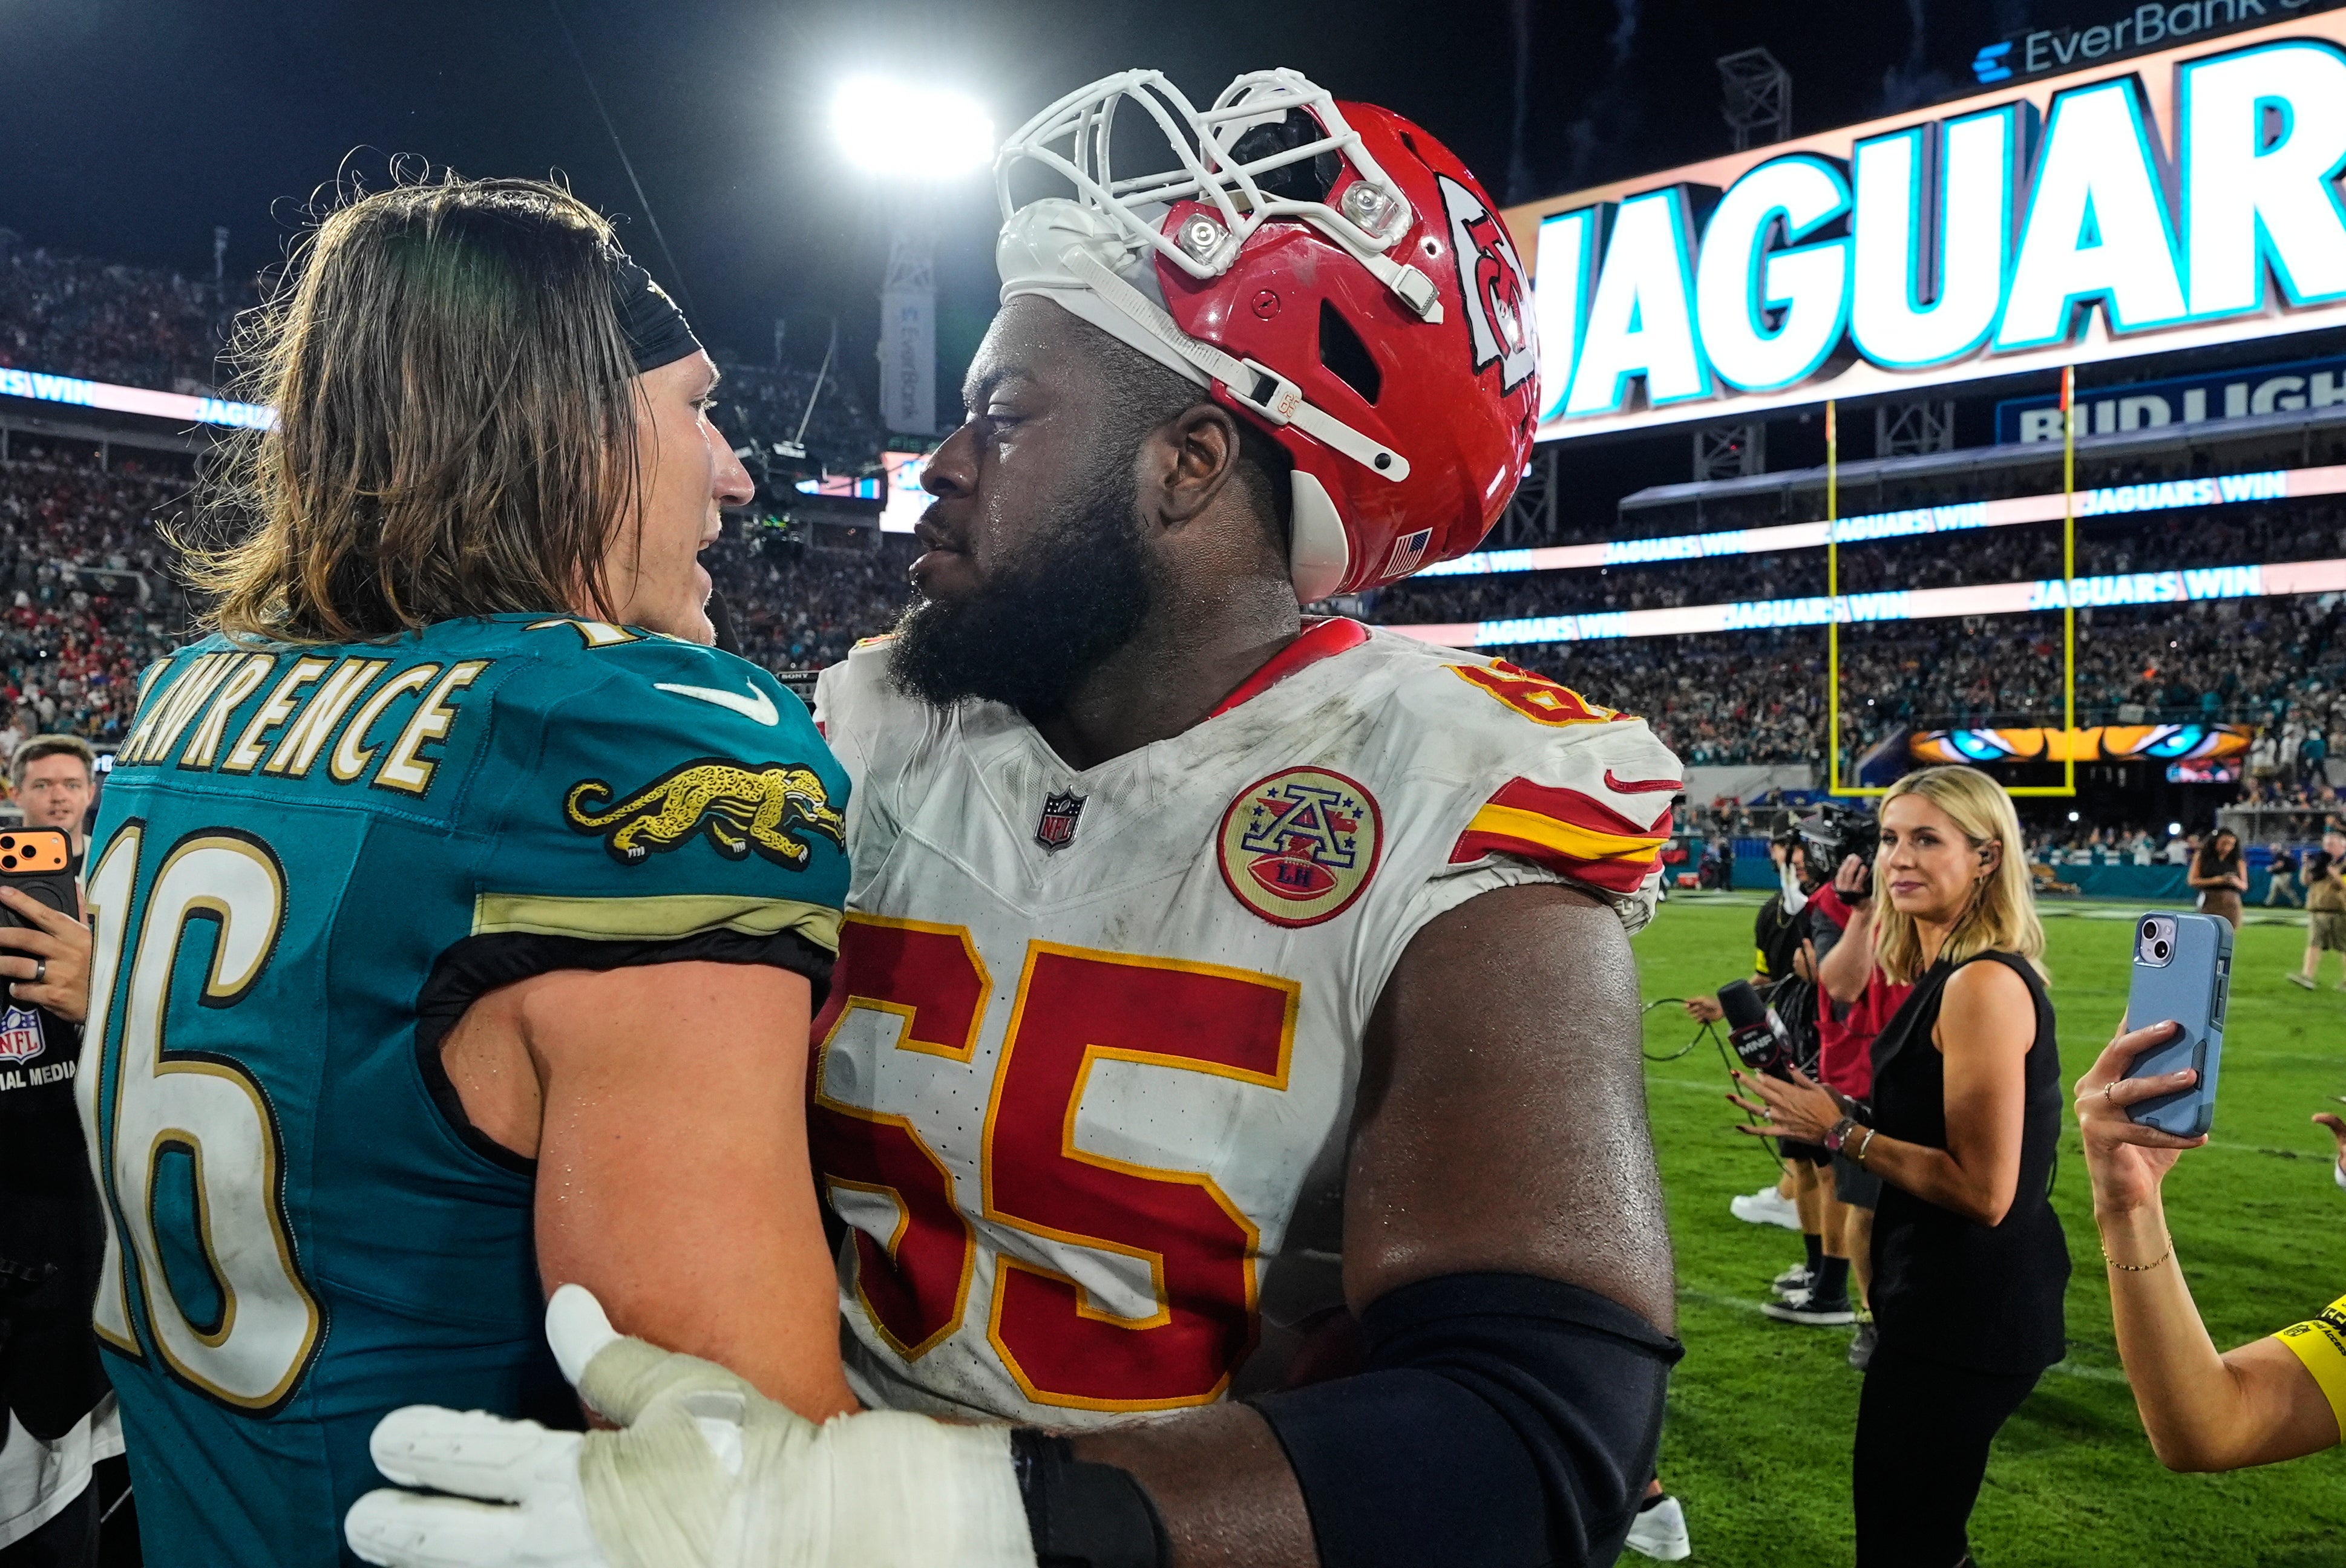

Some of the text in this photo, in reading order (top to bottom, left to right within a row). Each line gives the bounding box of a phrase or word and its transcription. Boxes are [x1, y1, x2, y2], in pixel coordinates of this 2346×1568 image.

[31, 371, 94, 406] WIN
[2083, 471, 2287, 517] JAGUARS WIN
[1932, 501, 1987, 531] WIN
[1488, 549, 1532, 572] WIN
[1604, 531, 1746, 565] JAGUARS WIN
[2029, 565, 2261, 610] JAGUARS WIN
[1848, 590, 1910, 622] WIN
[1475, 612, 1628, 647] JAGUARS WIN
[0, 1030, 38, 1056] NFL
[29, 1060, 76, 1086] MEDIA
[74, 817, 330, 1419] 16
[806, 911, 1302, 1412] 65
